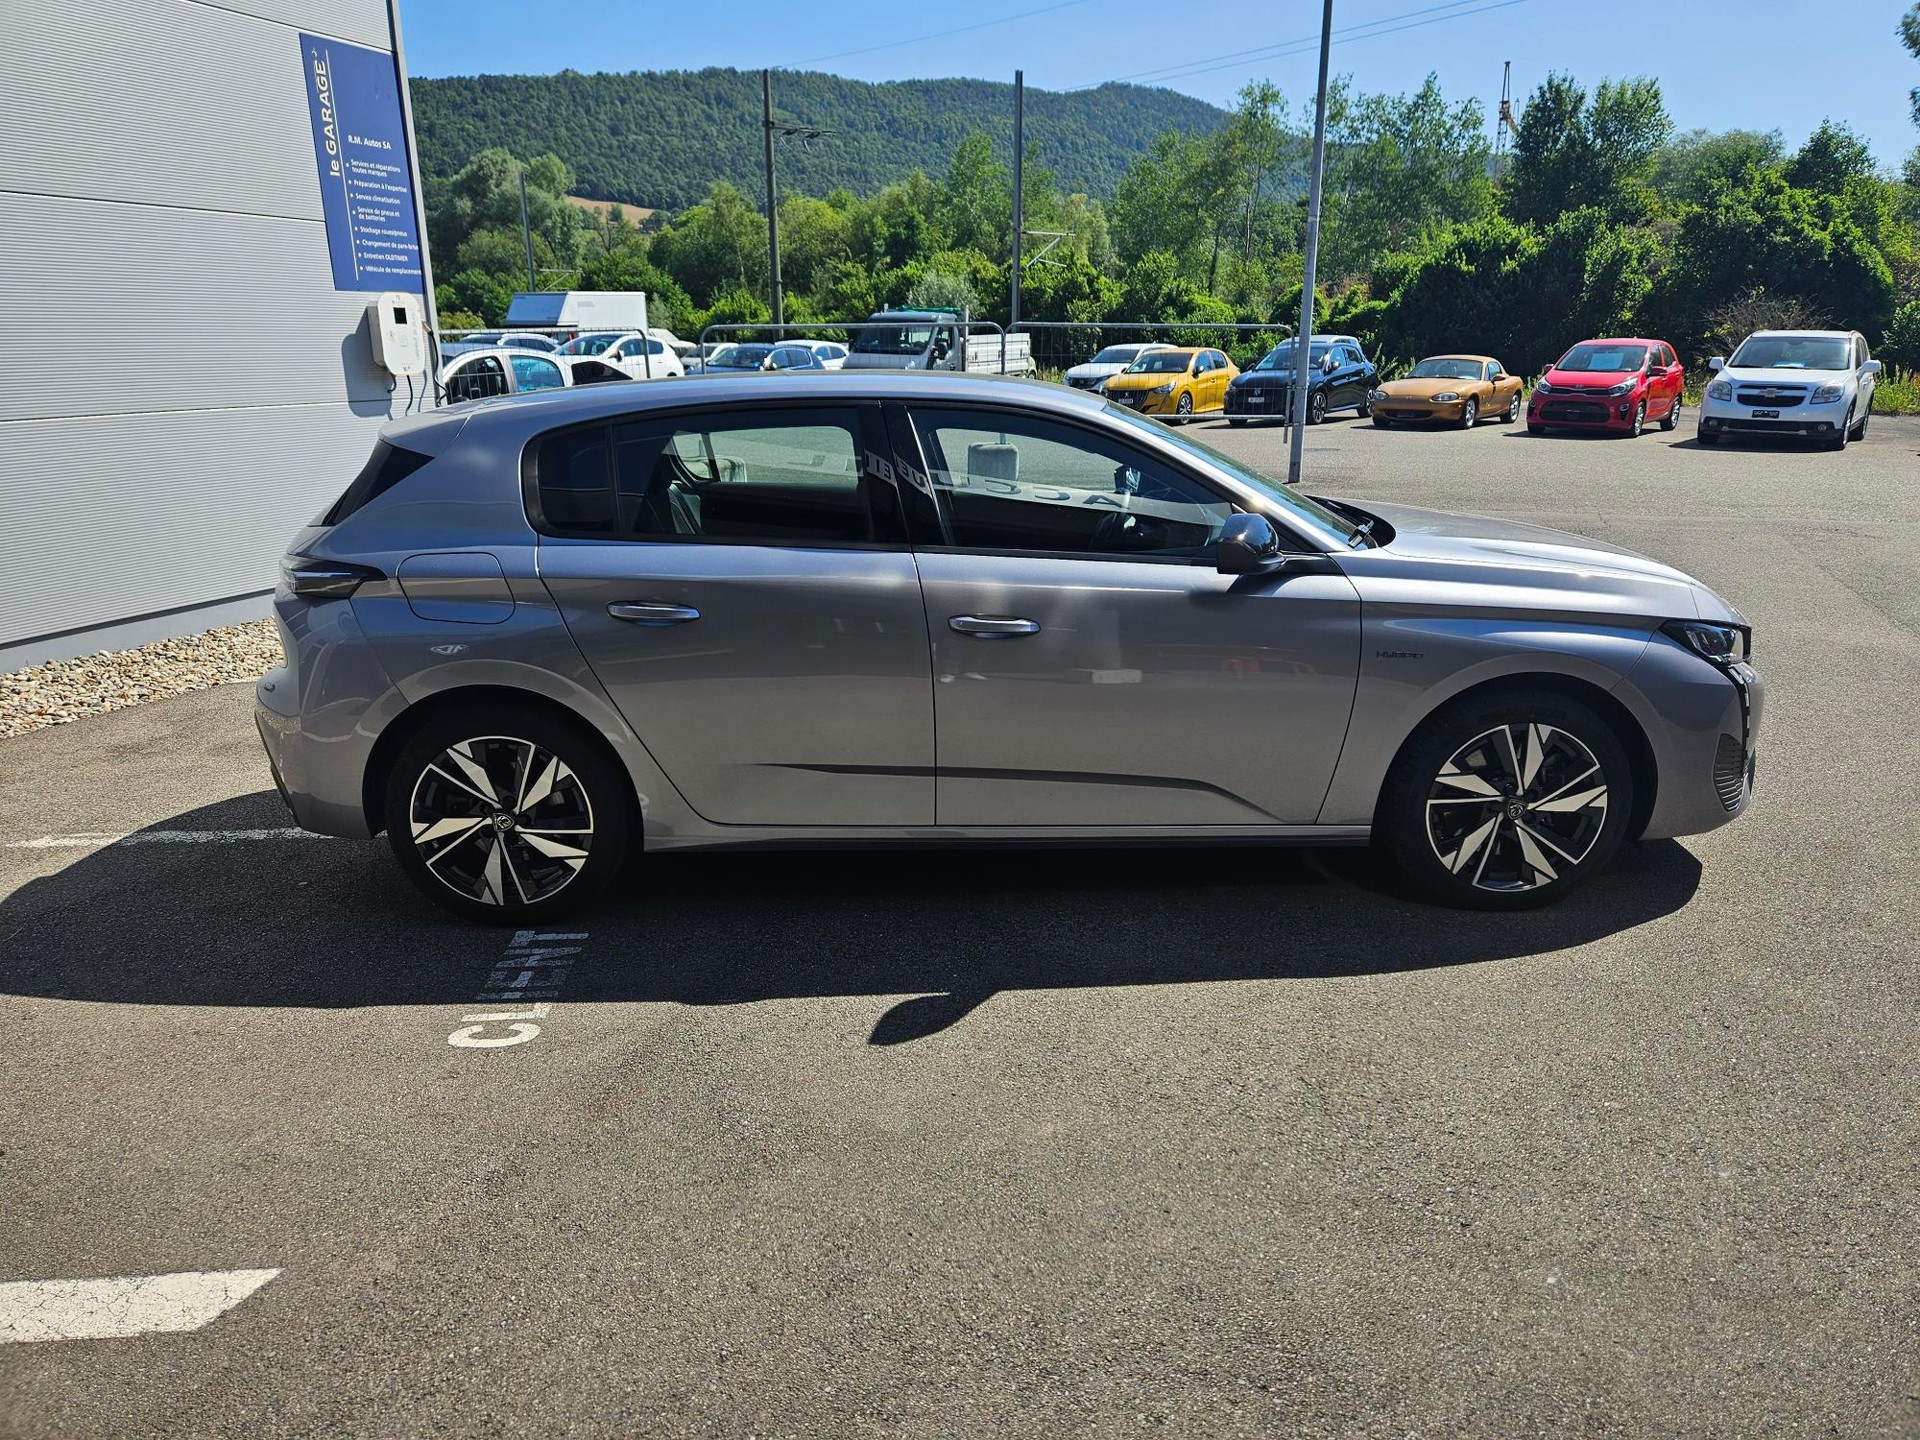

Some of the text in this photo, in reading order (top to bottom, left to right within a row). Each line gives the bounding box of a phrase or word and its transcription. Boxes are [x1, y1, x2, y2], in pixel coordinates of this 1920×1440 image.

[315, 60, 340, 177] le GARAGE
[347, 134, 392, 150] R.M. Autos SA
[351, 159, 370, 168] Services
[351, 166, 388, 178] toutes marques
[353, 179, 381, 189] Préparation
[355, 193, 401, 205] Service climatisation
[357, 206, 374, 214] Service
[380, 209, 394, 217] pneus
[365, 213, 386, 222] batteries
[360, 226, 381, 235] Stockage
[362, 239, 391, 248] Changement
[363, 252, 385, 260] Entretien
[447, 930, 590, 1048] CLIENT
